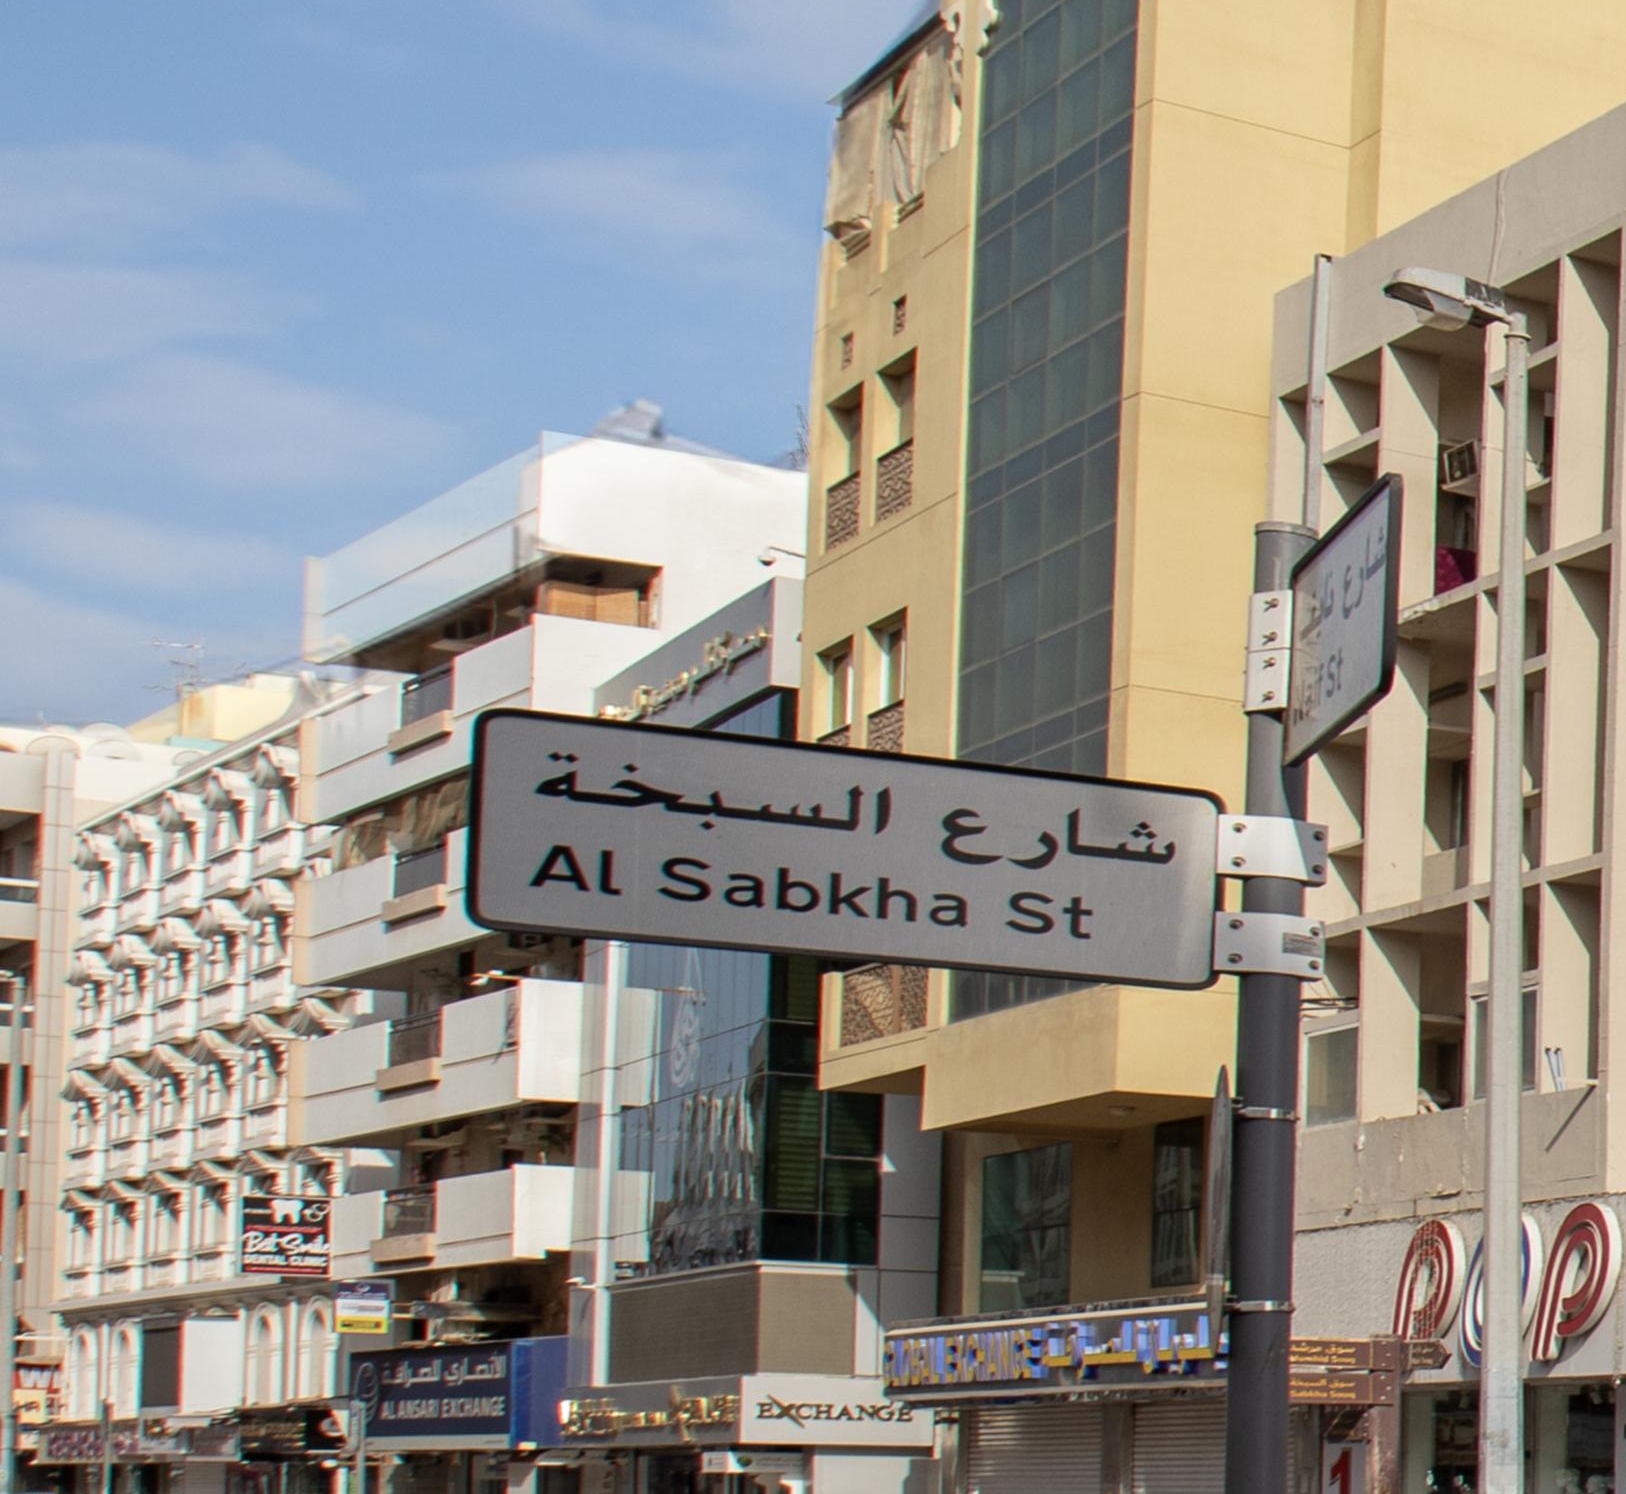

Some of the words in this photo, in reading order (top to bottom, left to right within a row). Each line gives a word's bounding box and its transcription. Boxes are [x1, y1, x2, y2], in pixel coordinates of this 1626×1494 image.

[1326, 648, 1343, 699] St
[534, 751, 892, 835] السبخة
[941, 807, 1176, 870] شارع
[529, 844, 622, 896] Al
[657, 857, 969, 928] Sabkha
[1005, 892, 1094, 940] St
[380, 1401, 396, 1421] AL
[397, 1399, 438, 1420] ANSARI
[440, 1396, 506, 1419] EXCHANGE
[756, 1394, 914, 1429] EXCHANGE
